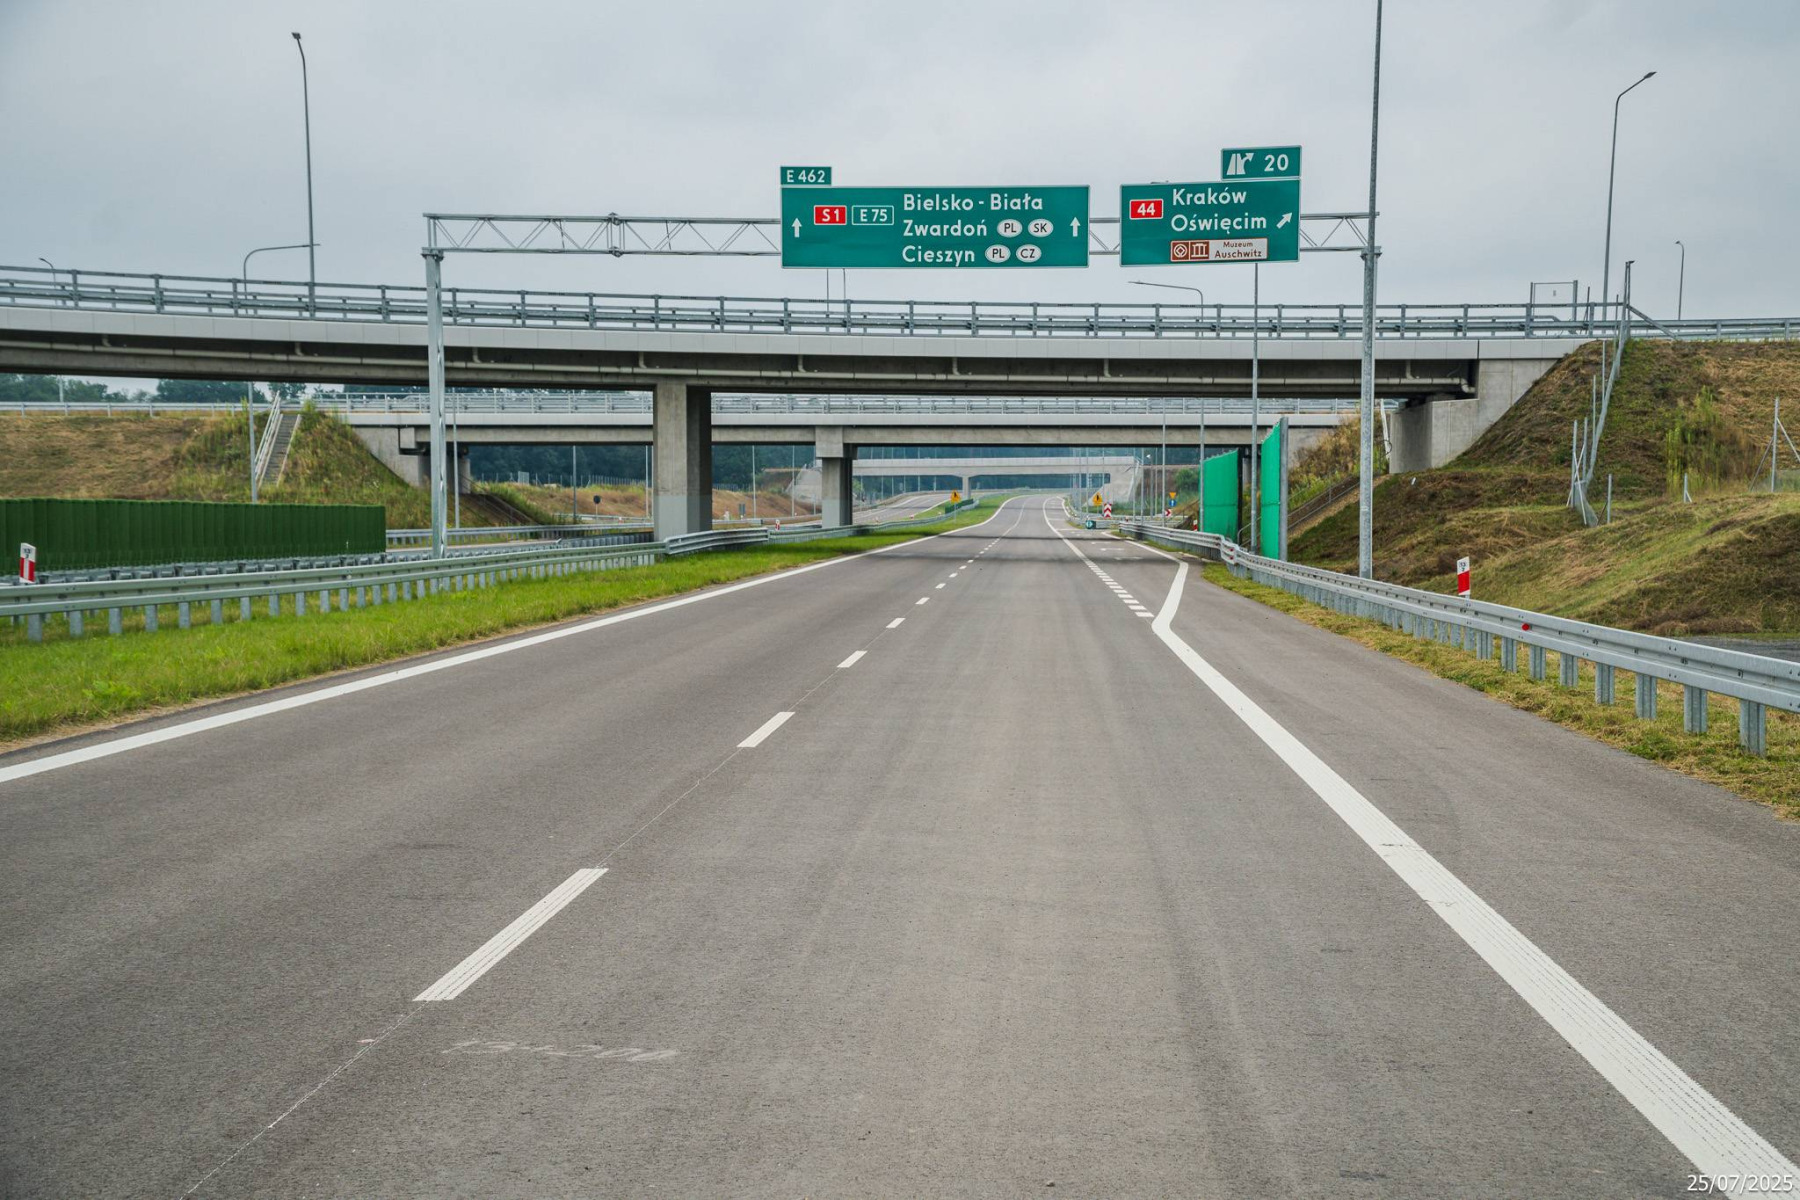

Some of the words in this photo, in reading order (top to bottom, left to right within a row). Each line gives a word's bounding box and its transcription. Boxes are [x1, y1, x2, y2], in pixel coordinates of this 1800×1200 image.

[1264, 154, 1289, 172] 20
[903, 194, 974, 211] Bielsko
[990, 194, 1043, 211] Biała
[1172, 187, 1247, 206] Kraków
[1137, 203, 1156, 216] 44
[903, 219, 987, 237] Zwardoń
[1004, 222, 1018, 234] PL
[1034, 222, 1048, 234] SK
[1171, 212, 1267, 235] Oświęcim
[902, 245, 976, 267] Cieszyn
[992, 248, 1006, 260] PL
[1021, 248, 1035, 260] CZ
[1214, 250, 1262, 259] Auschwitz
